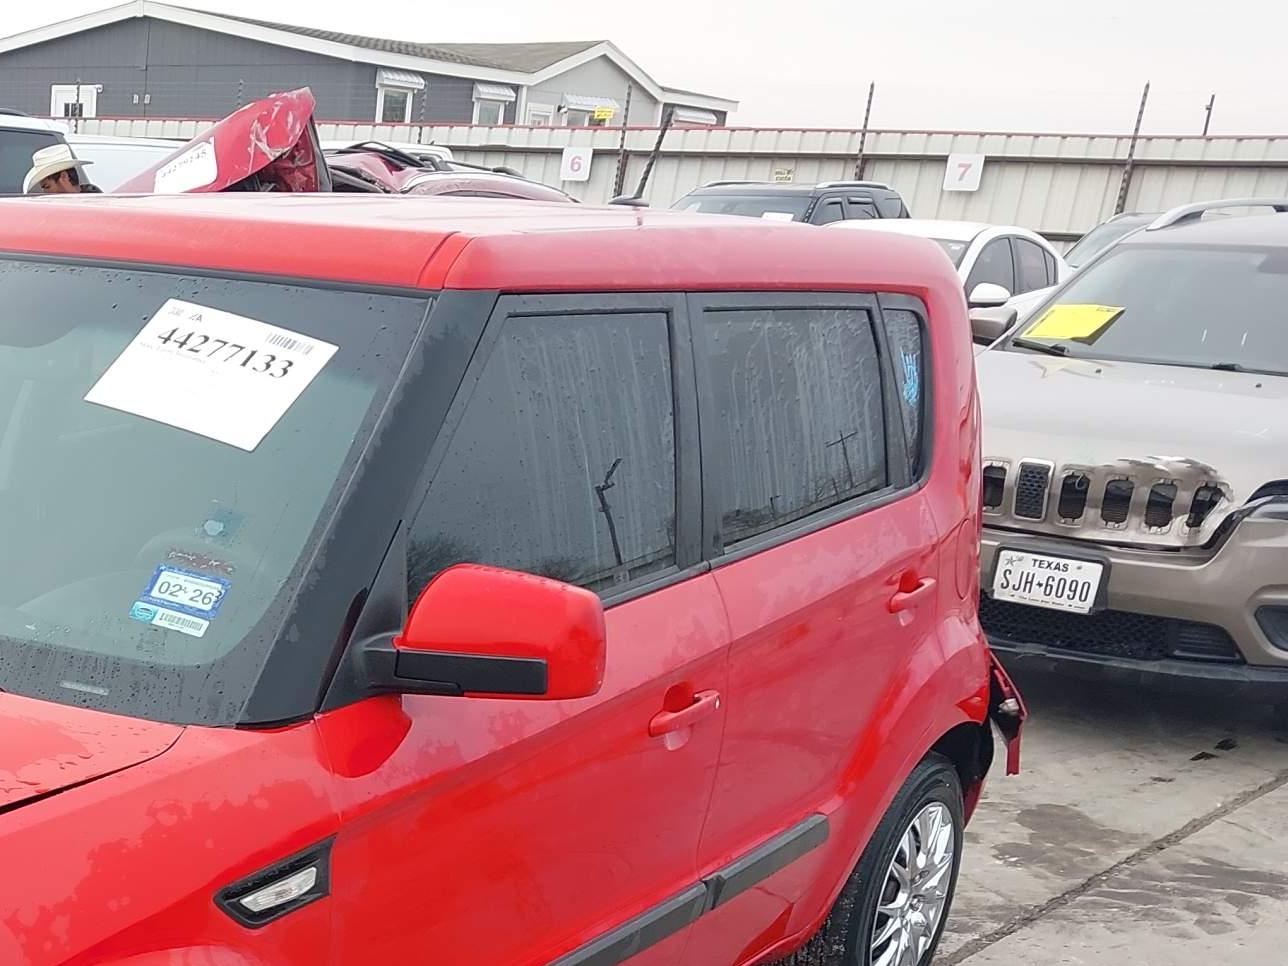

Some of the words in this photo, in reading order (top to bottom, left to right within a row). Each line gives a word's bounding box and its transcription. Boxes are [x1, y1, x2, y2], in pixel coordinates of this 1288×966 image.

[570, 155, 582, 172] 6
[957, 162, 972, 181] 7
[157, 327, 294, 379] 44277133
[1031, 558, 1070, 573] TEXAS
